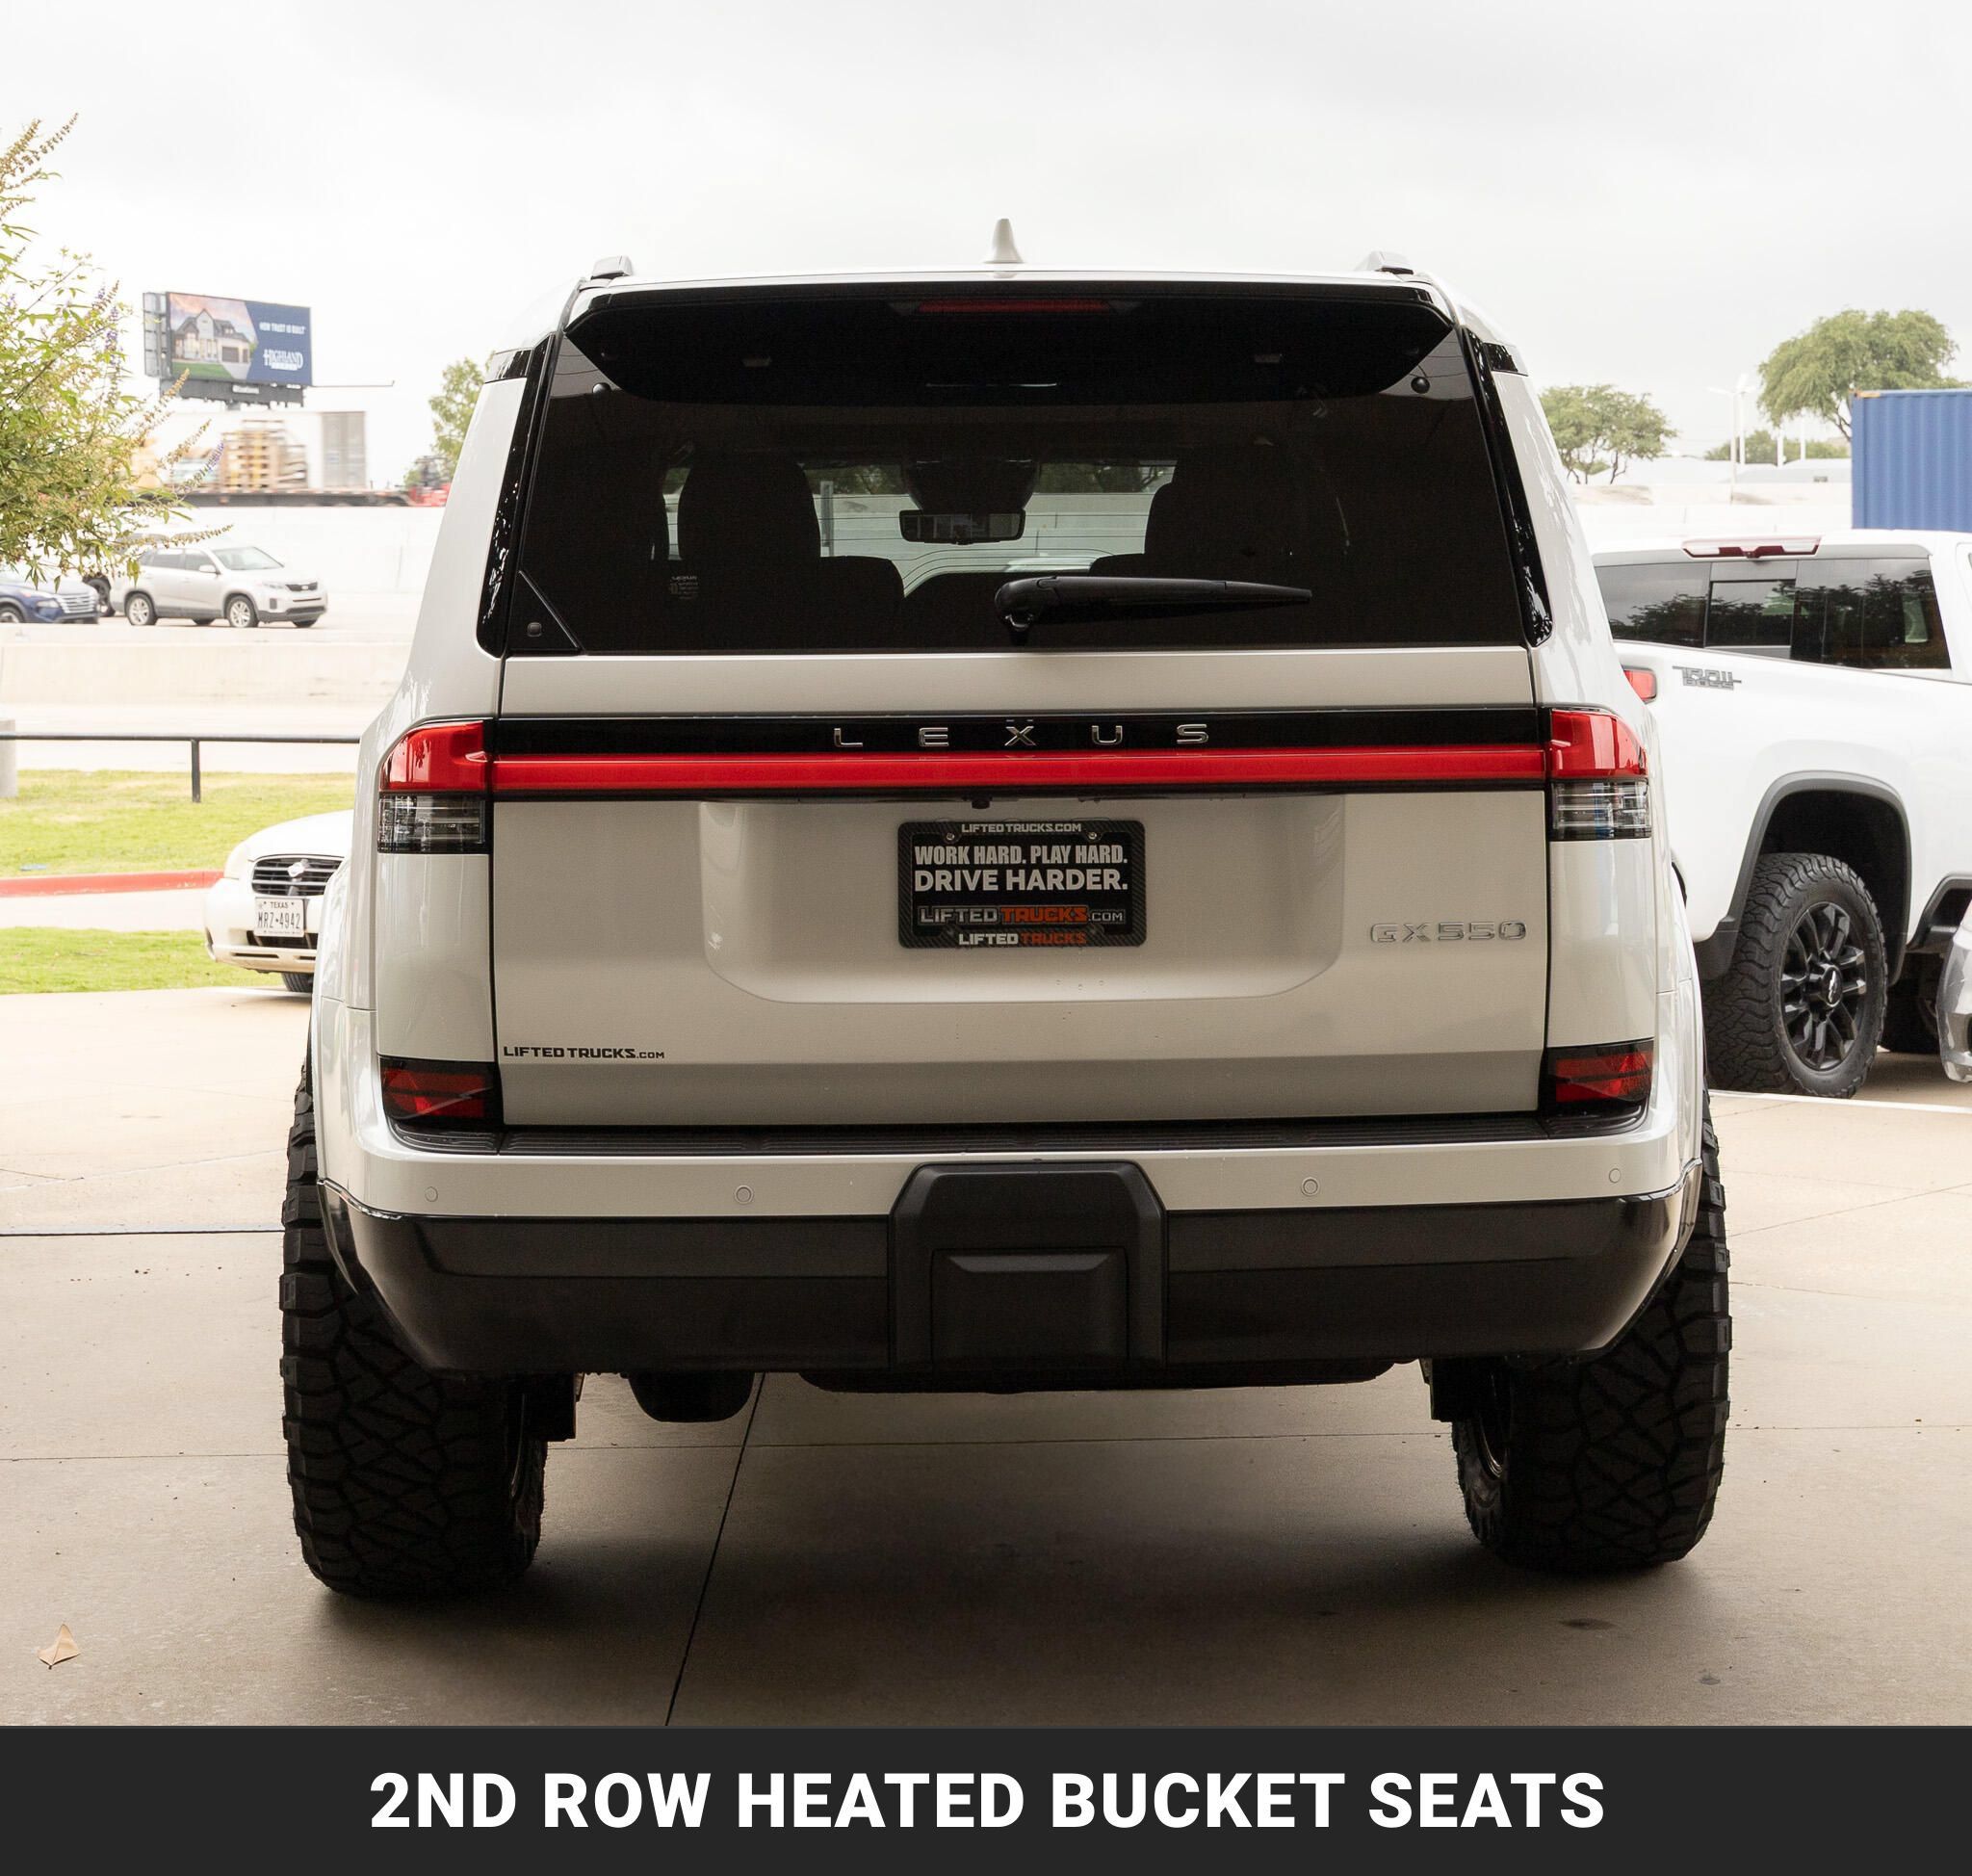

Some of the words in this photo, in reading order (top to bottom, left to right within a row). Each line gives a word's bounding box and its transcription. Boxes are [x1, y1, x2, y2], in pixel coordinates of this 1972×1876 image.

[833, 723, 1210, 747] LEXUS
[915, 846, 970, 865] WORK
[973, 846, 1026, 864] HARD.
[1030, 846, 1071, 864] PLAY
[1076, 845, 1128, 864] HARD.
[915, 870, 999, 892] DRIVE
[1006, 869, 1128, 891] HARDER.
[959, 933, 1019, 945] LIFTED
[1021, 932, 1087, 944] TRUCKS
